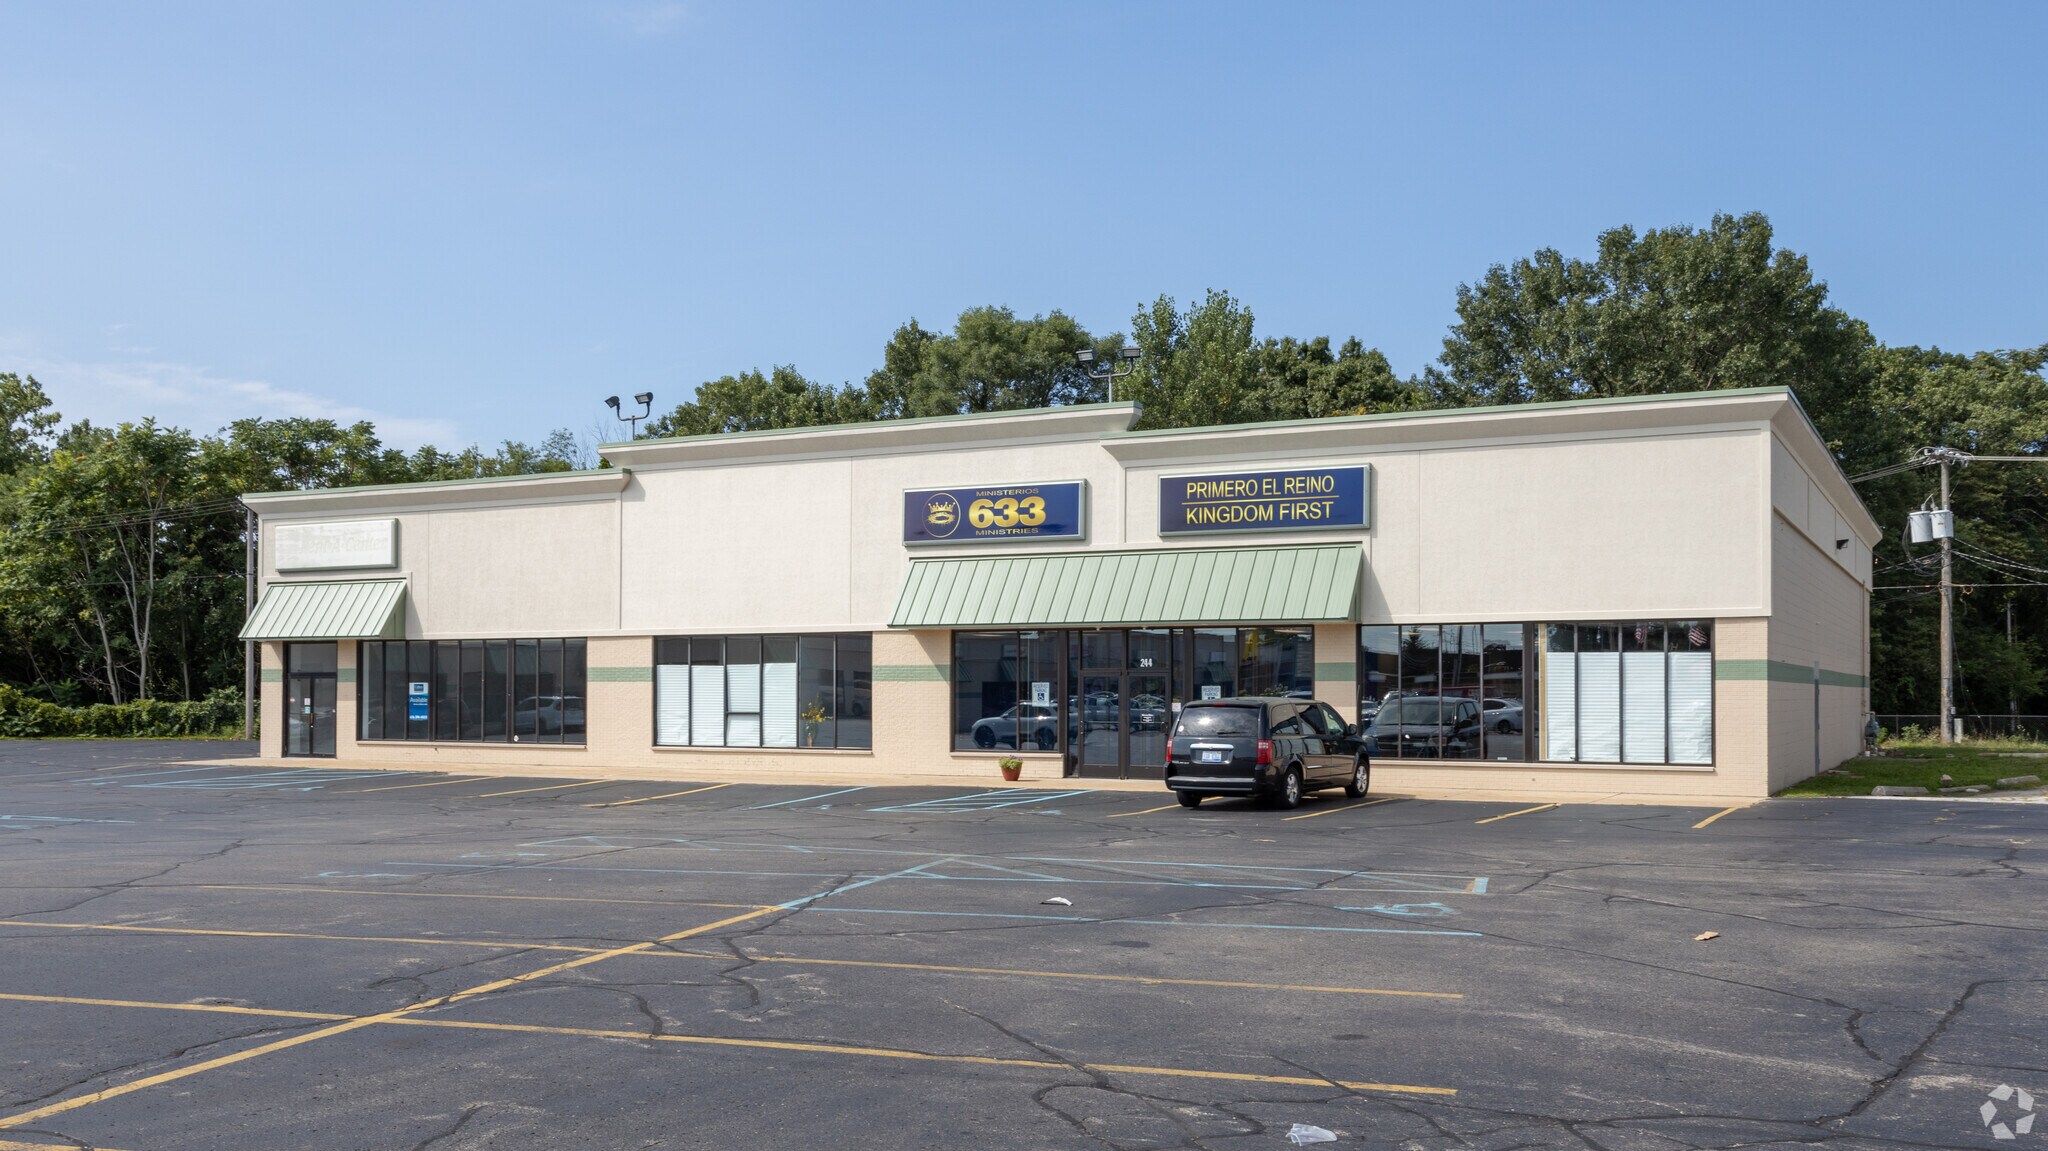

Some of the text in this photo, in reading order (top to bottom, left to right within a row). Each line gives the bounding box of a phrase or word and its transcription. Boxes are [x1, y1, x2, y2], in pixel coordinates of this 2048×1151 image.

[976, 488, 1039, 497] MINISTERIOS
[1186, 475, 1335, 499] PRIMERO EL REINO
[968, 496, 1047, 529] 633
[1186, 501, 1335, 525] KINGDOM FIRST
[975, 527, 1039, 536] MINISTRIES
[1140, 658, 1153, 668] 244
